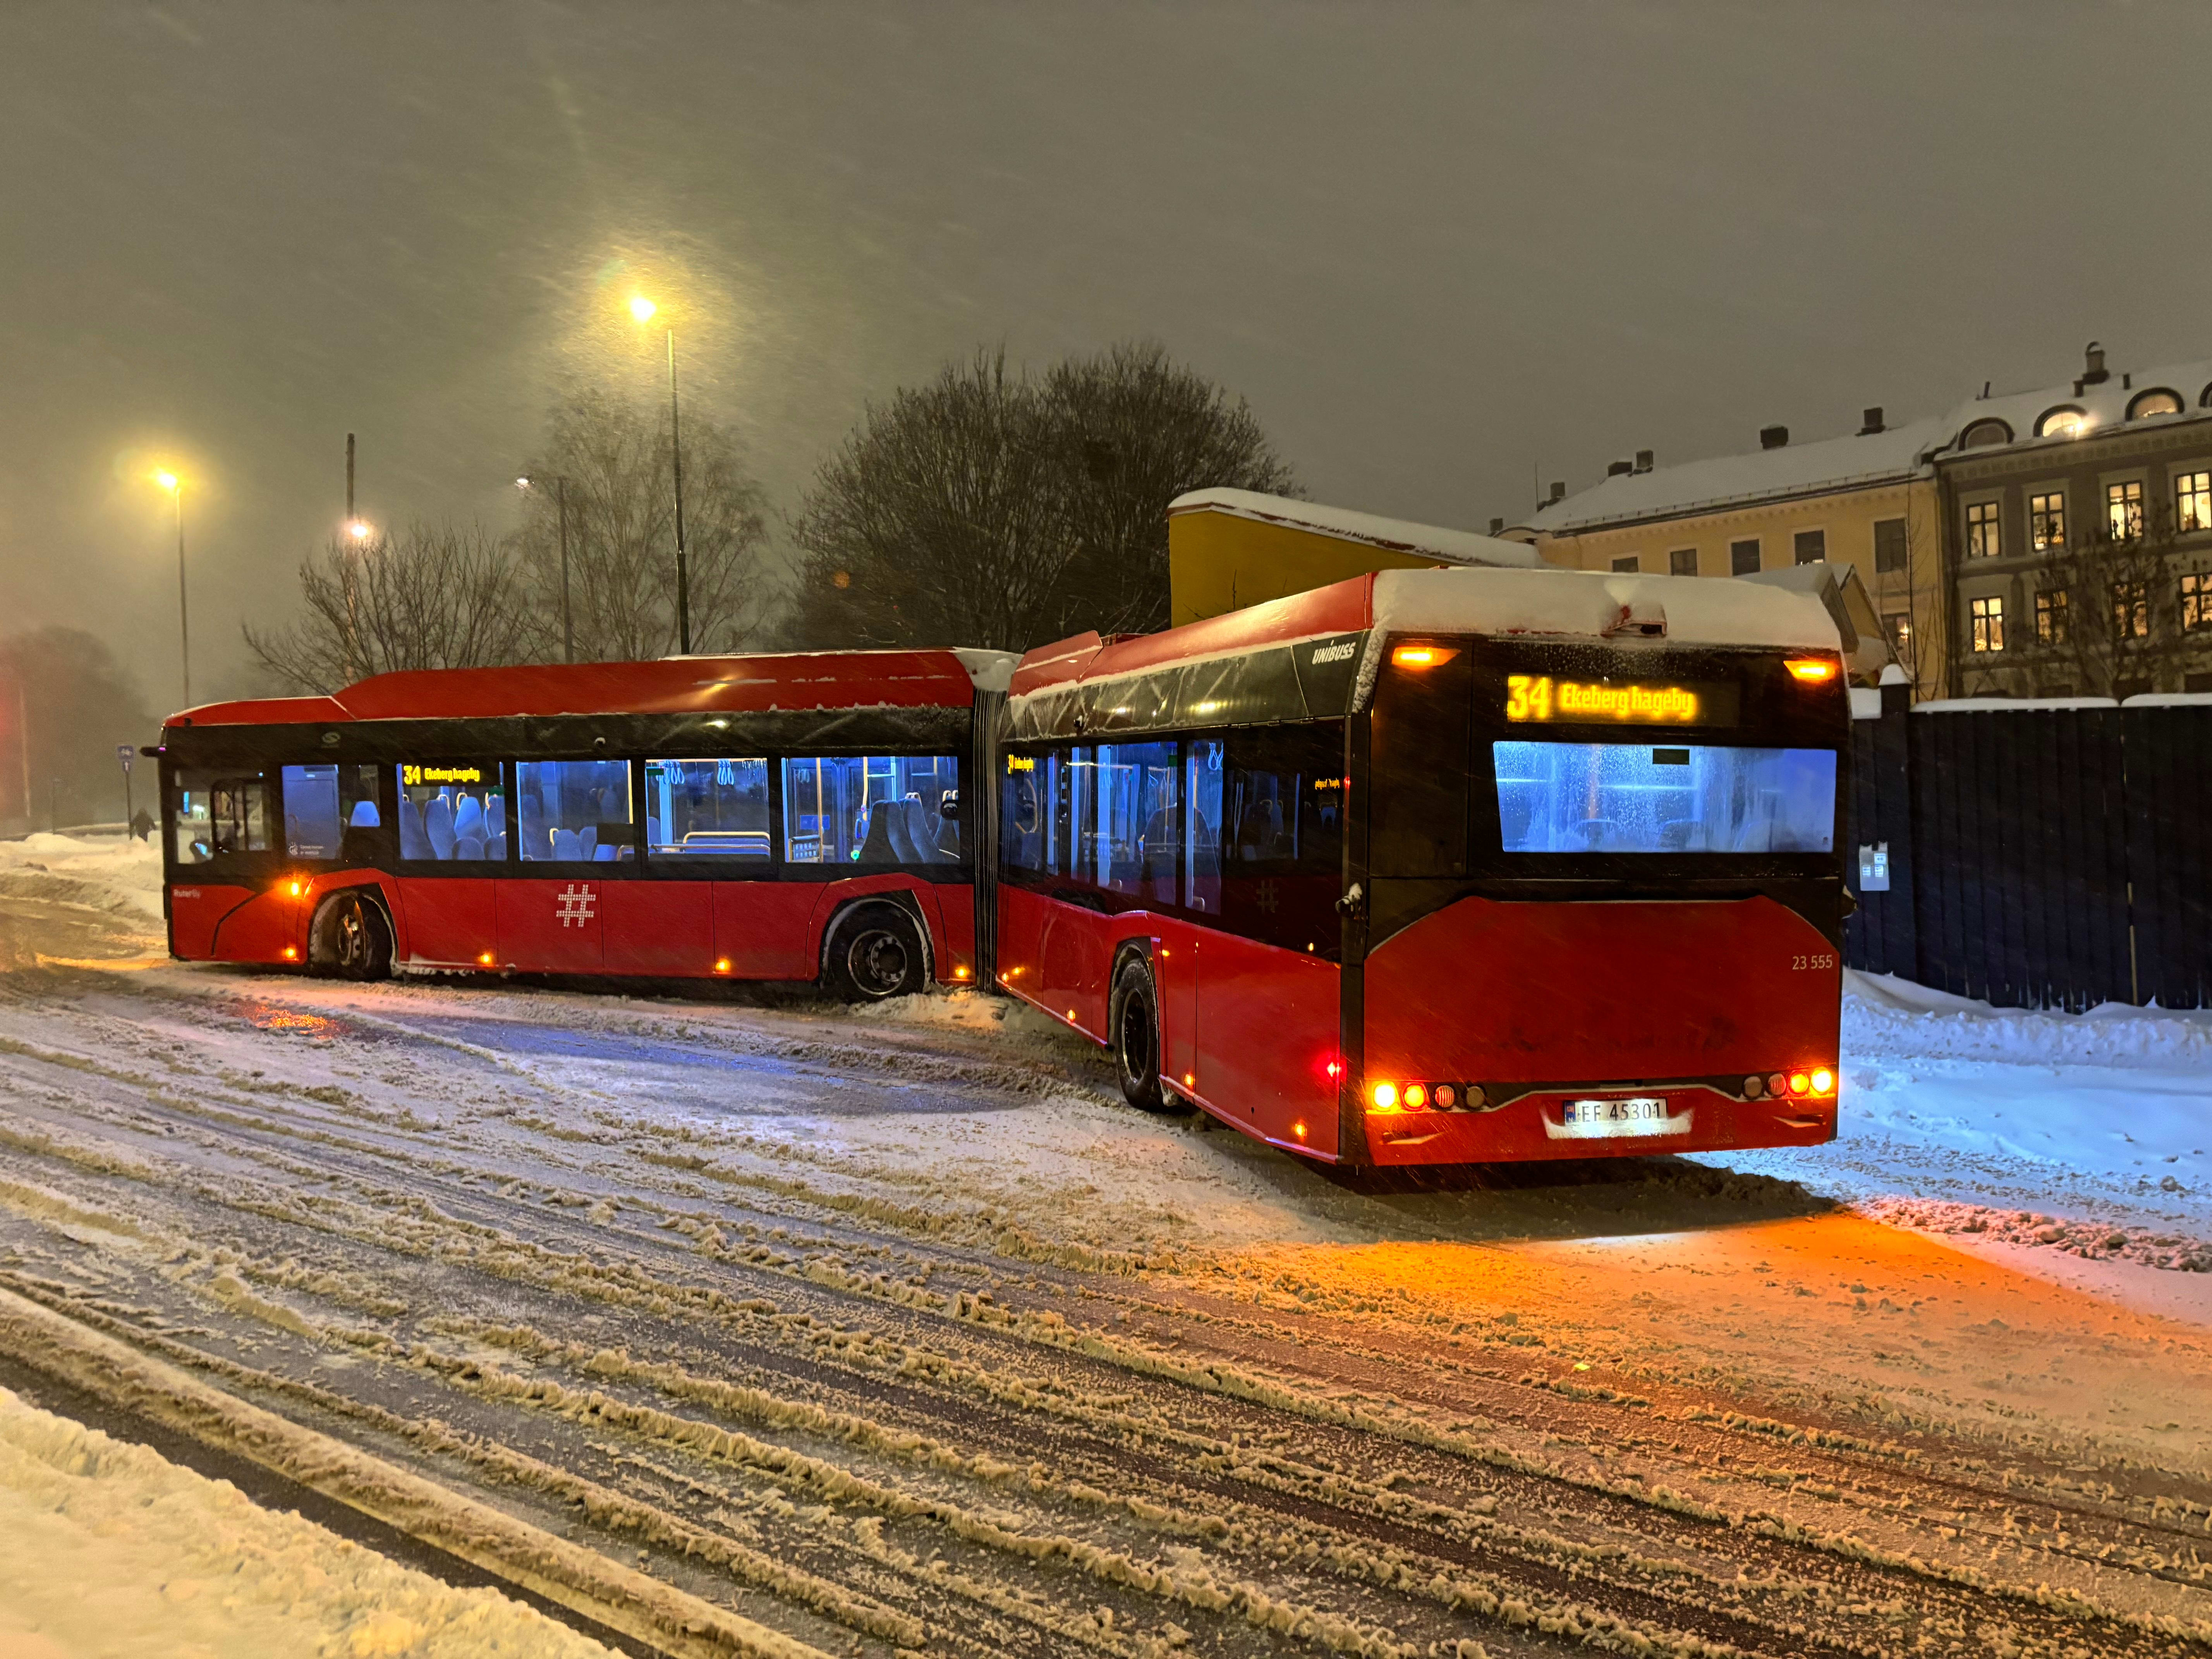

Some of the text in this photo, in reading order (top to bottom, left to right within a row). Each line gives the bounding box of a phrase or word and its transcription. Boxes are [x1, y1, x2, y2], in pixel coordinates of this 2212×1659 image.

[1507, 676, 1695, 720] 34 Ekeberg hageby
[404, 765, 480, 785] 34 Ekeberg hageby
[1792, 954, 1833, 970] 23 555
[1582, 1104, 1601, 1123] EF
[1609, 1102, 1660, 1121] 45301
